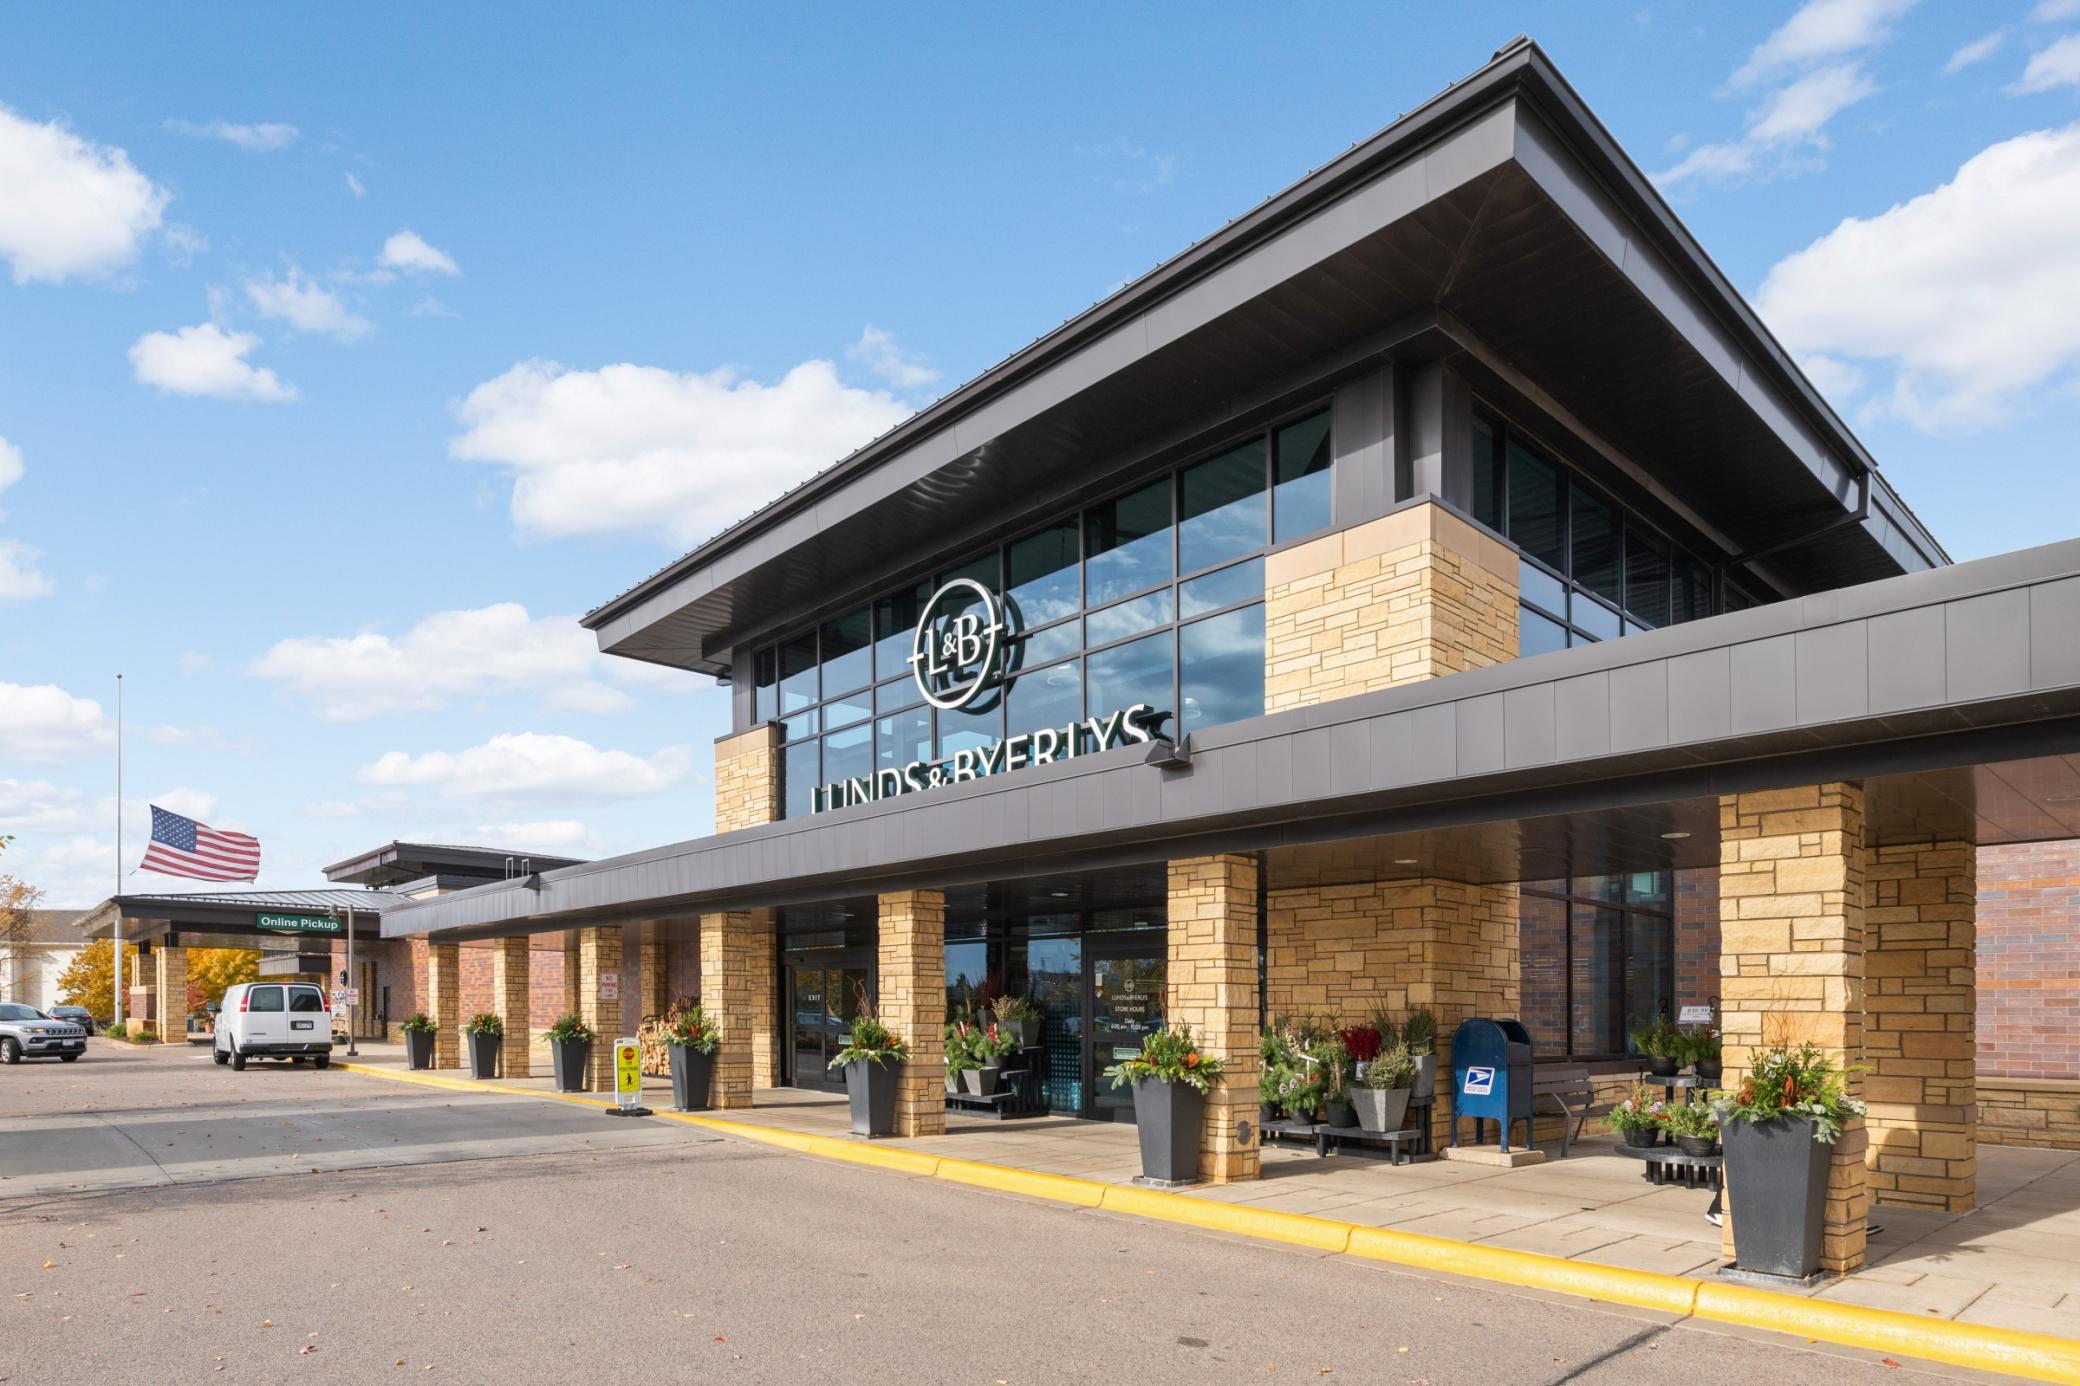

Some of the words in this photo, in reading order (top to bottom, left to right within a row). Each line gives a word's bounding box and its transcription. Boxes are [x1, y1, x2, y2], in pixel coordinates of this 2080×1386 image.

[925, 614, 981, 675] L&B
[261, 917, 298, 927] Online
[301, 919, 338, 930] Pickup
[808, 993, 821, 1001] EXIT
